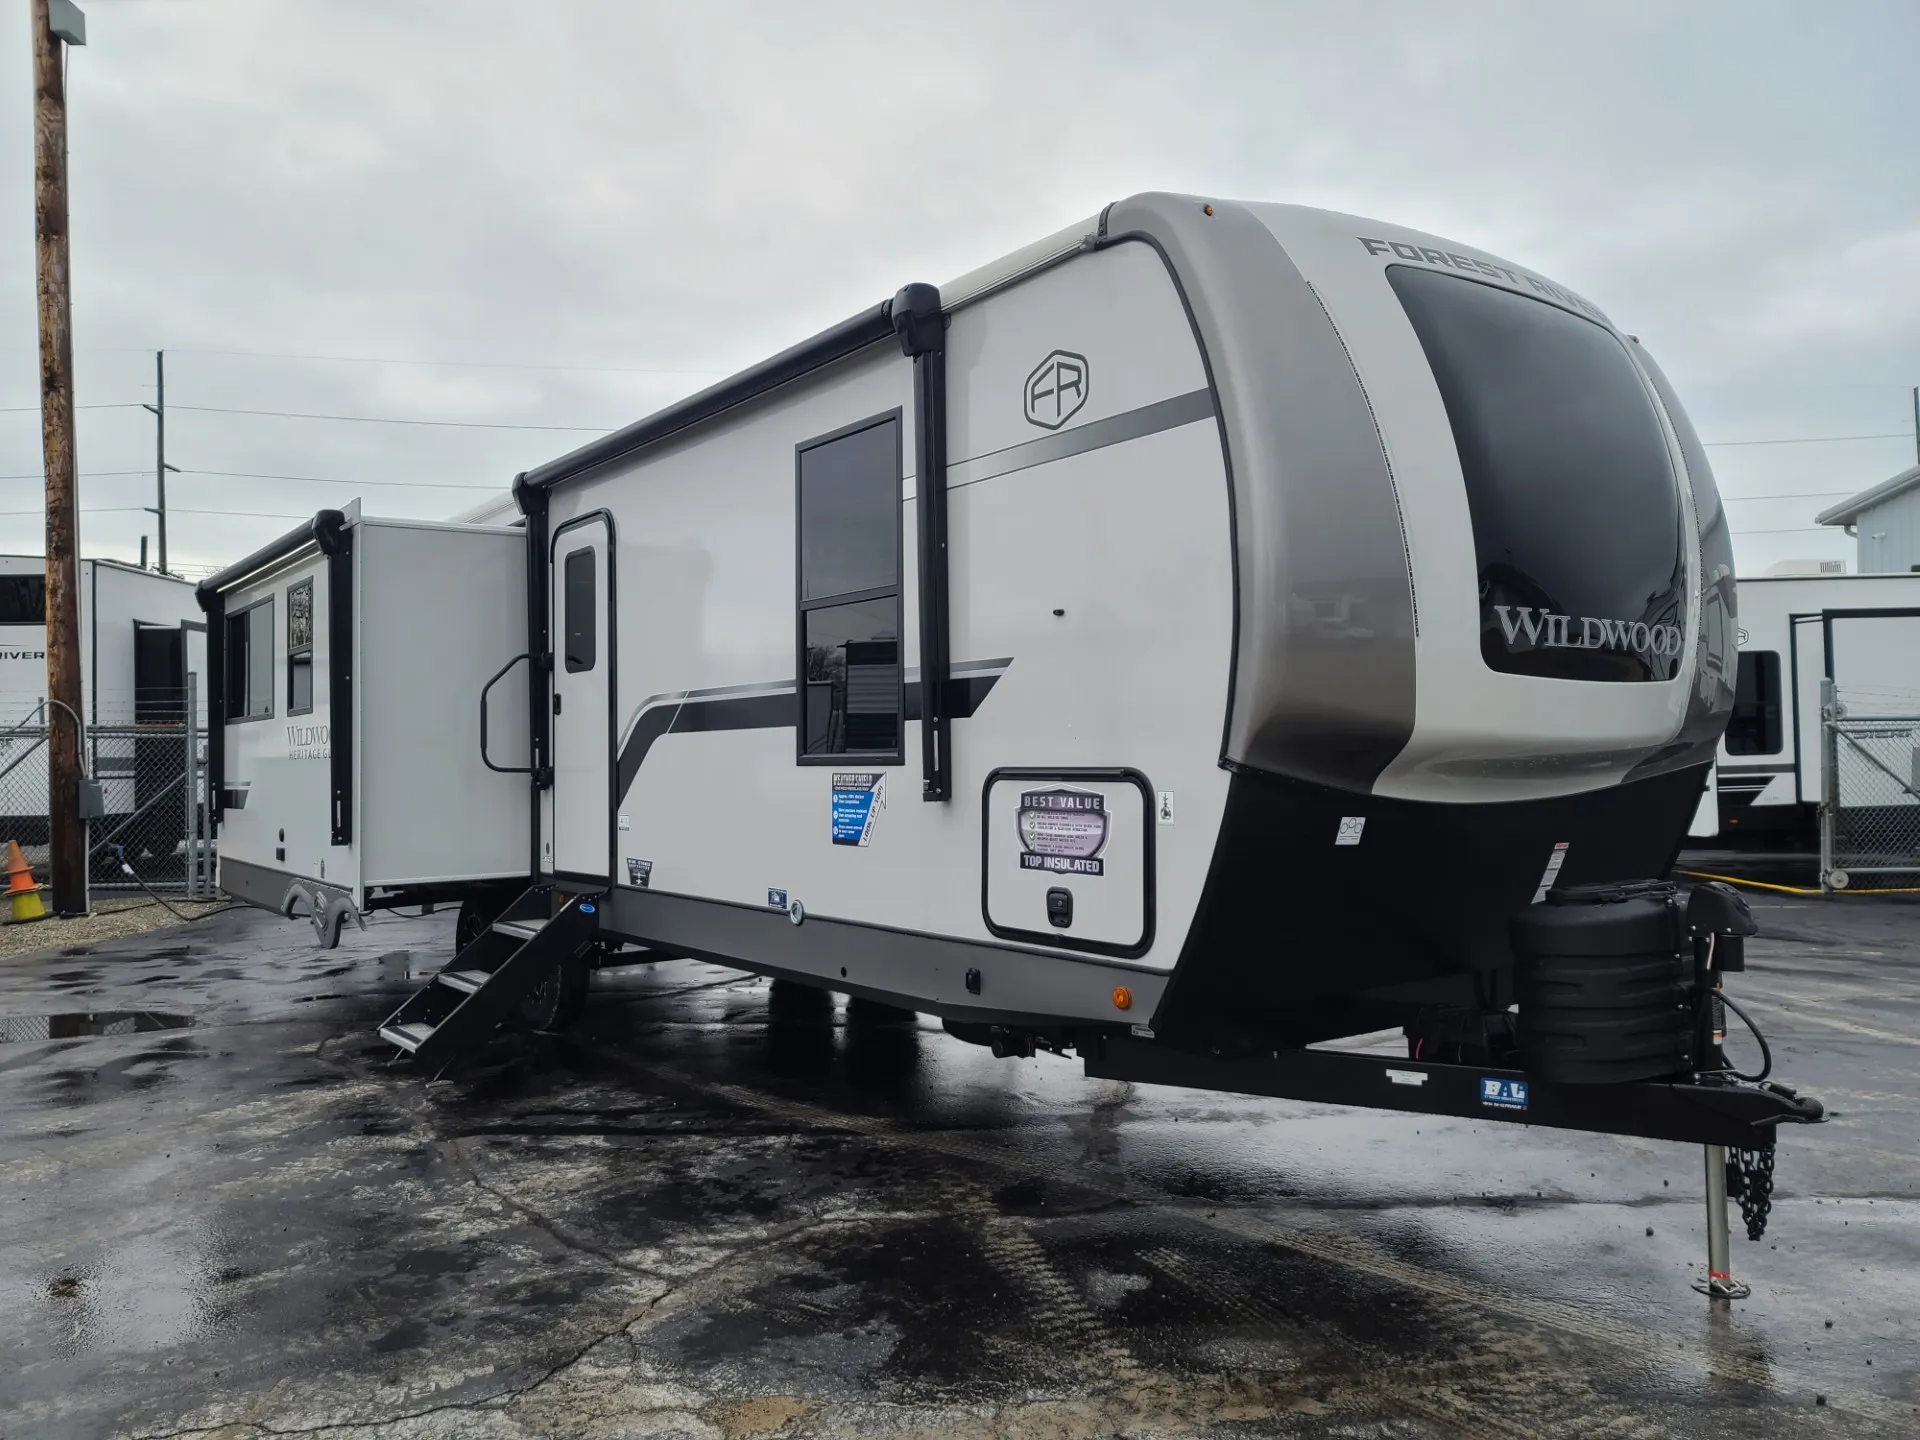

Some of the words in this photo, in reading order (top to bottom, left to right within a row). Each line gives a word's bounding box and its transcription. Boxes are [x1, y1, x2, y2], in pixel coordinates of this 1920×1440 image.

[1355, 236, 1519, 284] FOREST
[1494, 605, 1681, 656] WILDWOOD
[286, 725, 331, 746] WILDWO
[289, 748, 321, 760] HERITAGE
[1024, 795, 1054, 808] BEST
[1060, 797, 1101, 810] VALUE
[1023, 854, 1042, 867] TOP
[1044, 857, 1100, 873] INSULATED
